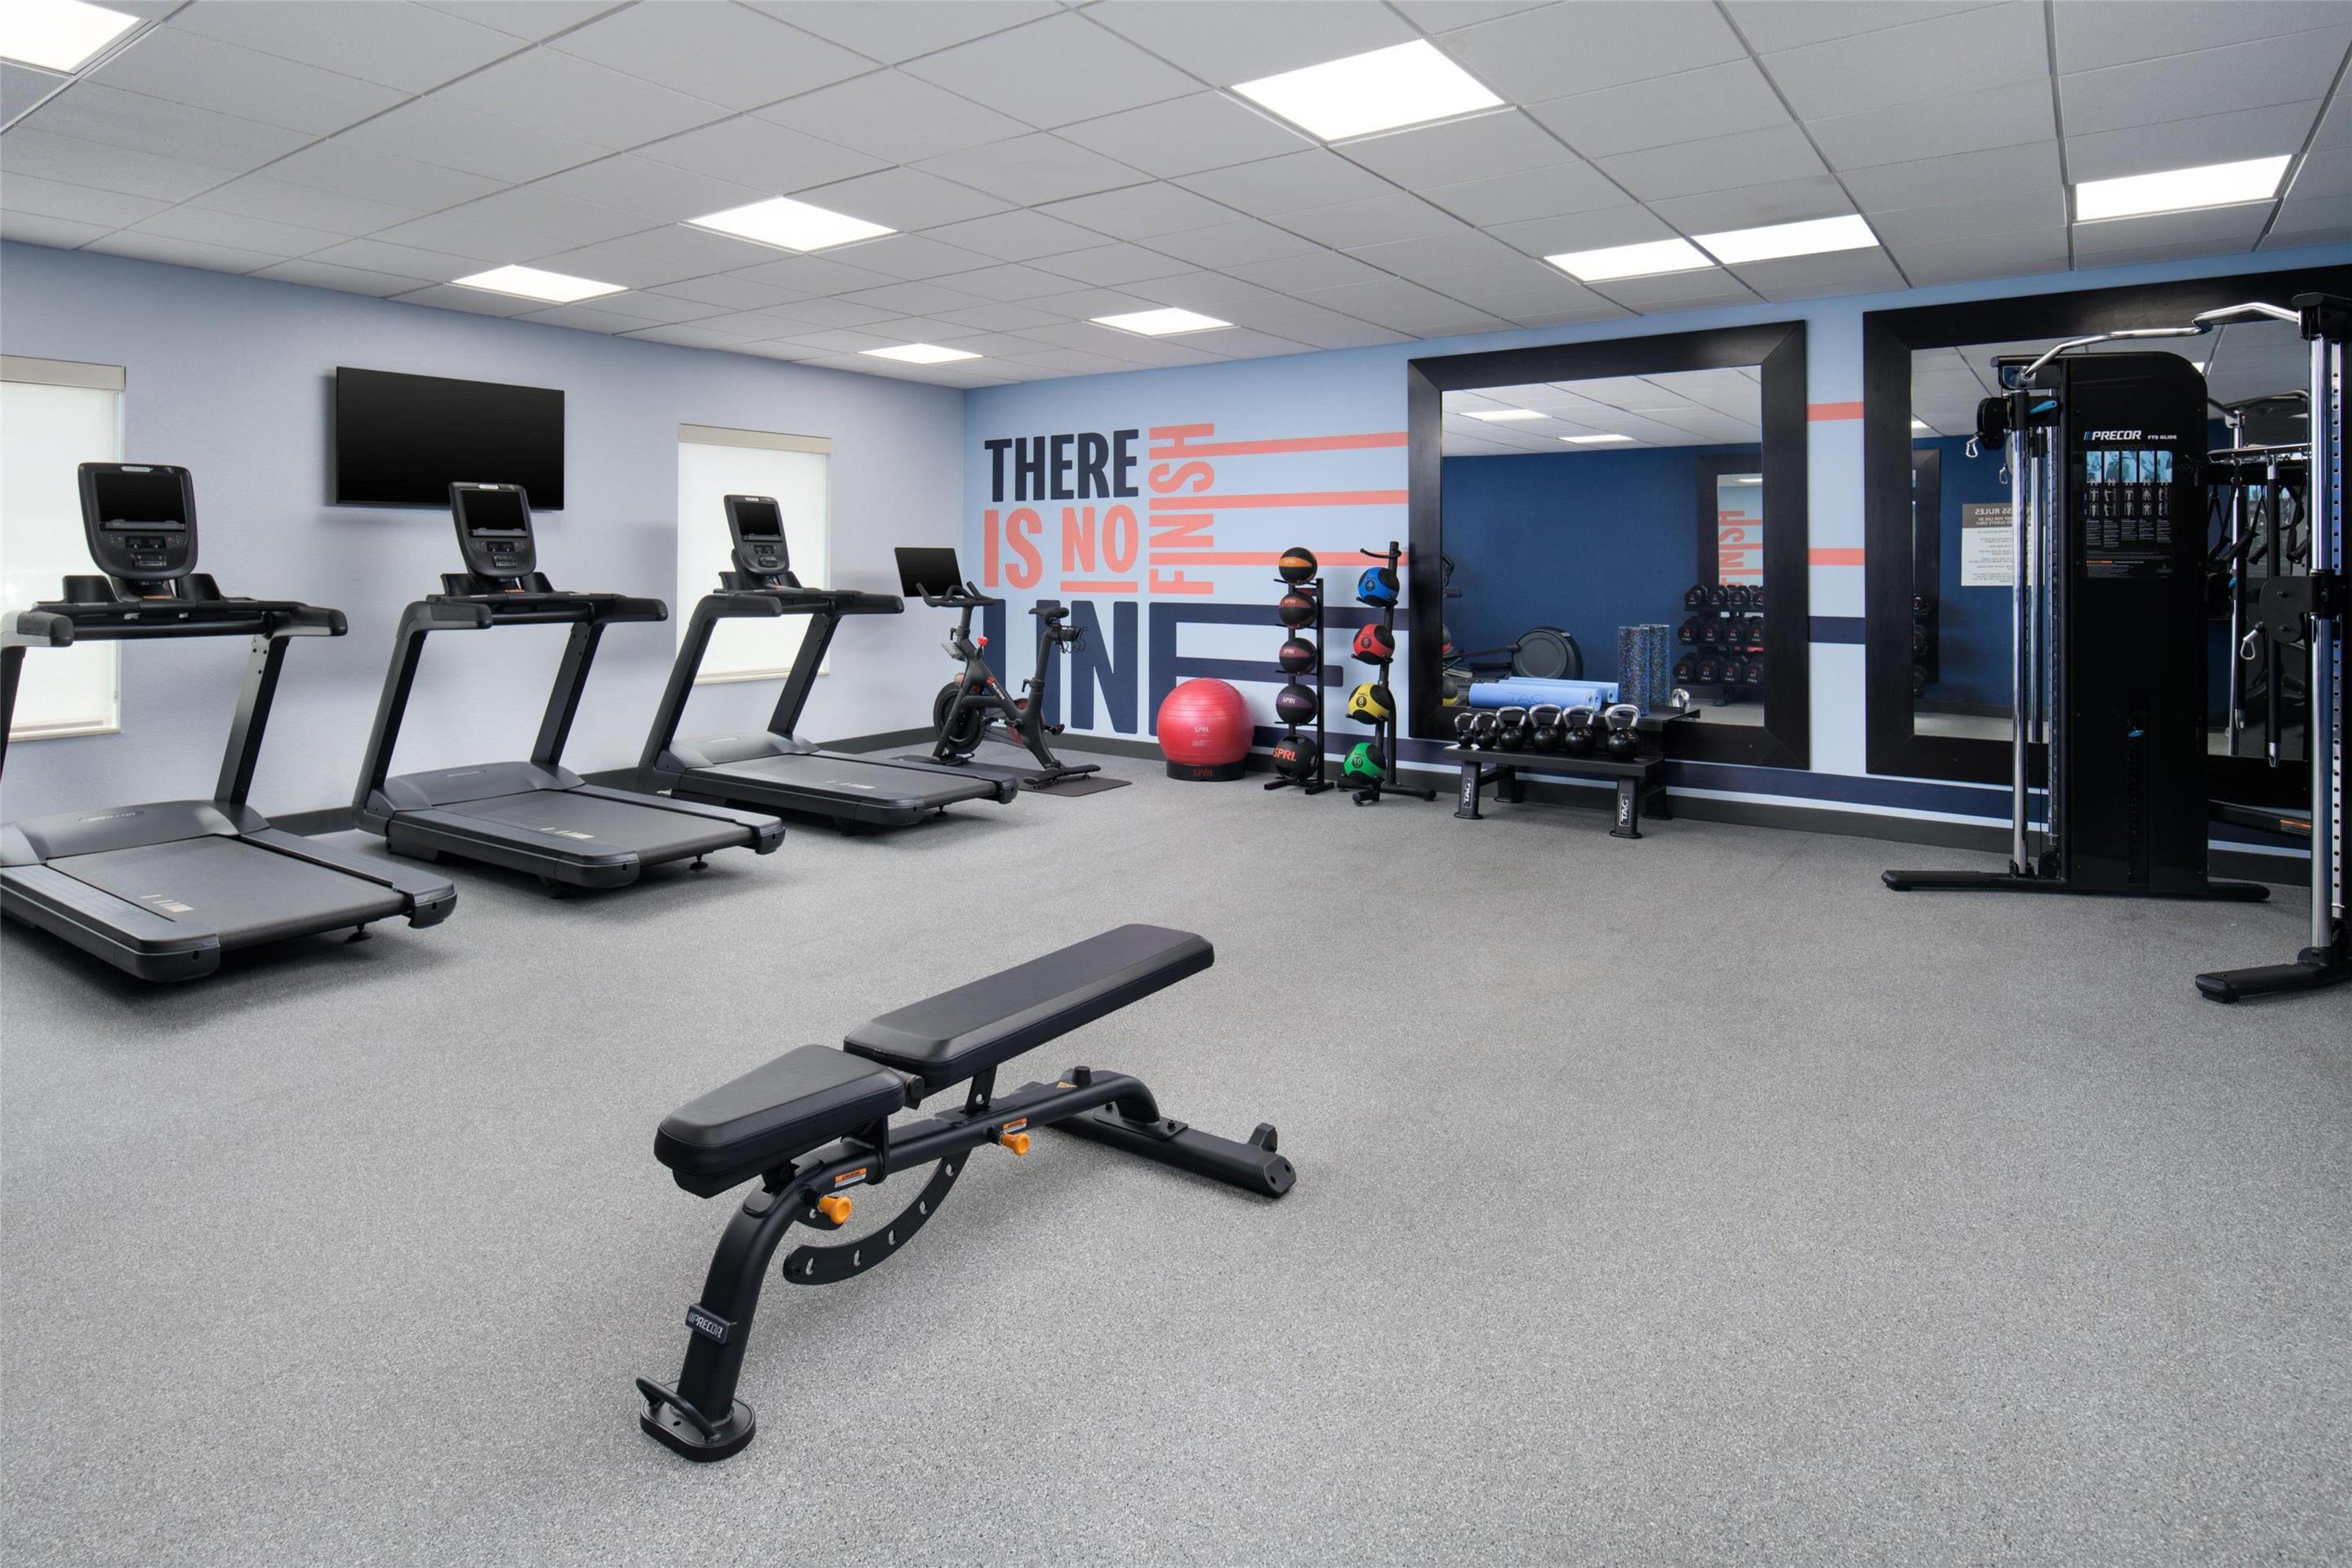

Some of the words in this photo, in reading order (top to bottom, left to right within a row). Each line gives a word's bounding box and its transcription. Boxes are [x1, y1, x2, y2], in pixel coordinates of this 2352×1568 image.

[2091, 430, 2141, 441] PRECOR
[984, 429, 1139, 502] THERE
[1148, 423, 1215, 595] FINISH
[984, 508, 1043, 589] IS
[1062, 505, 1138, 573] NO
[1358, 697, 1364, 705] 8
[1273, 747, 1295, 761] SPRI
[1192, 769, 1213, 777] SPRI
[692, 1313, 724, 1339] PRECOR
